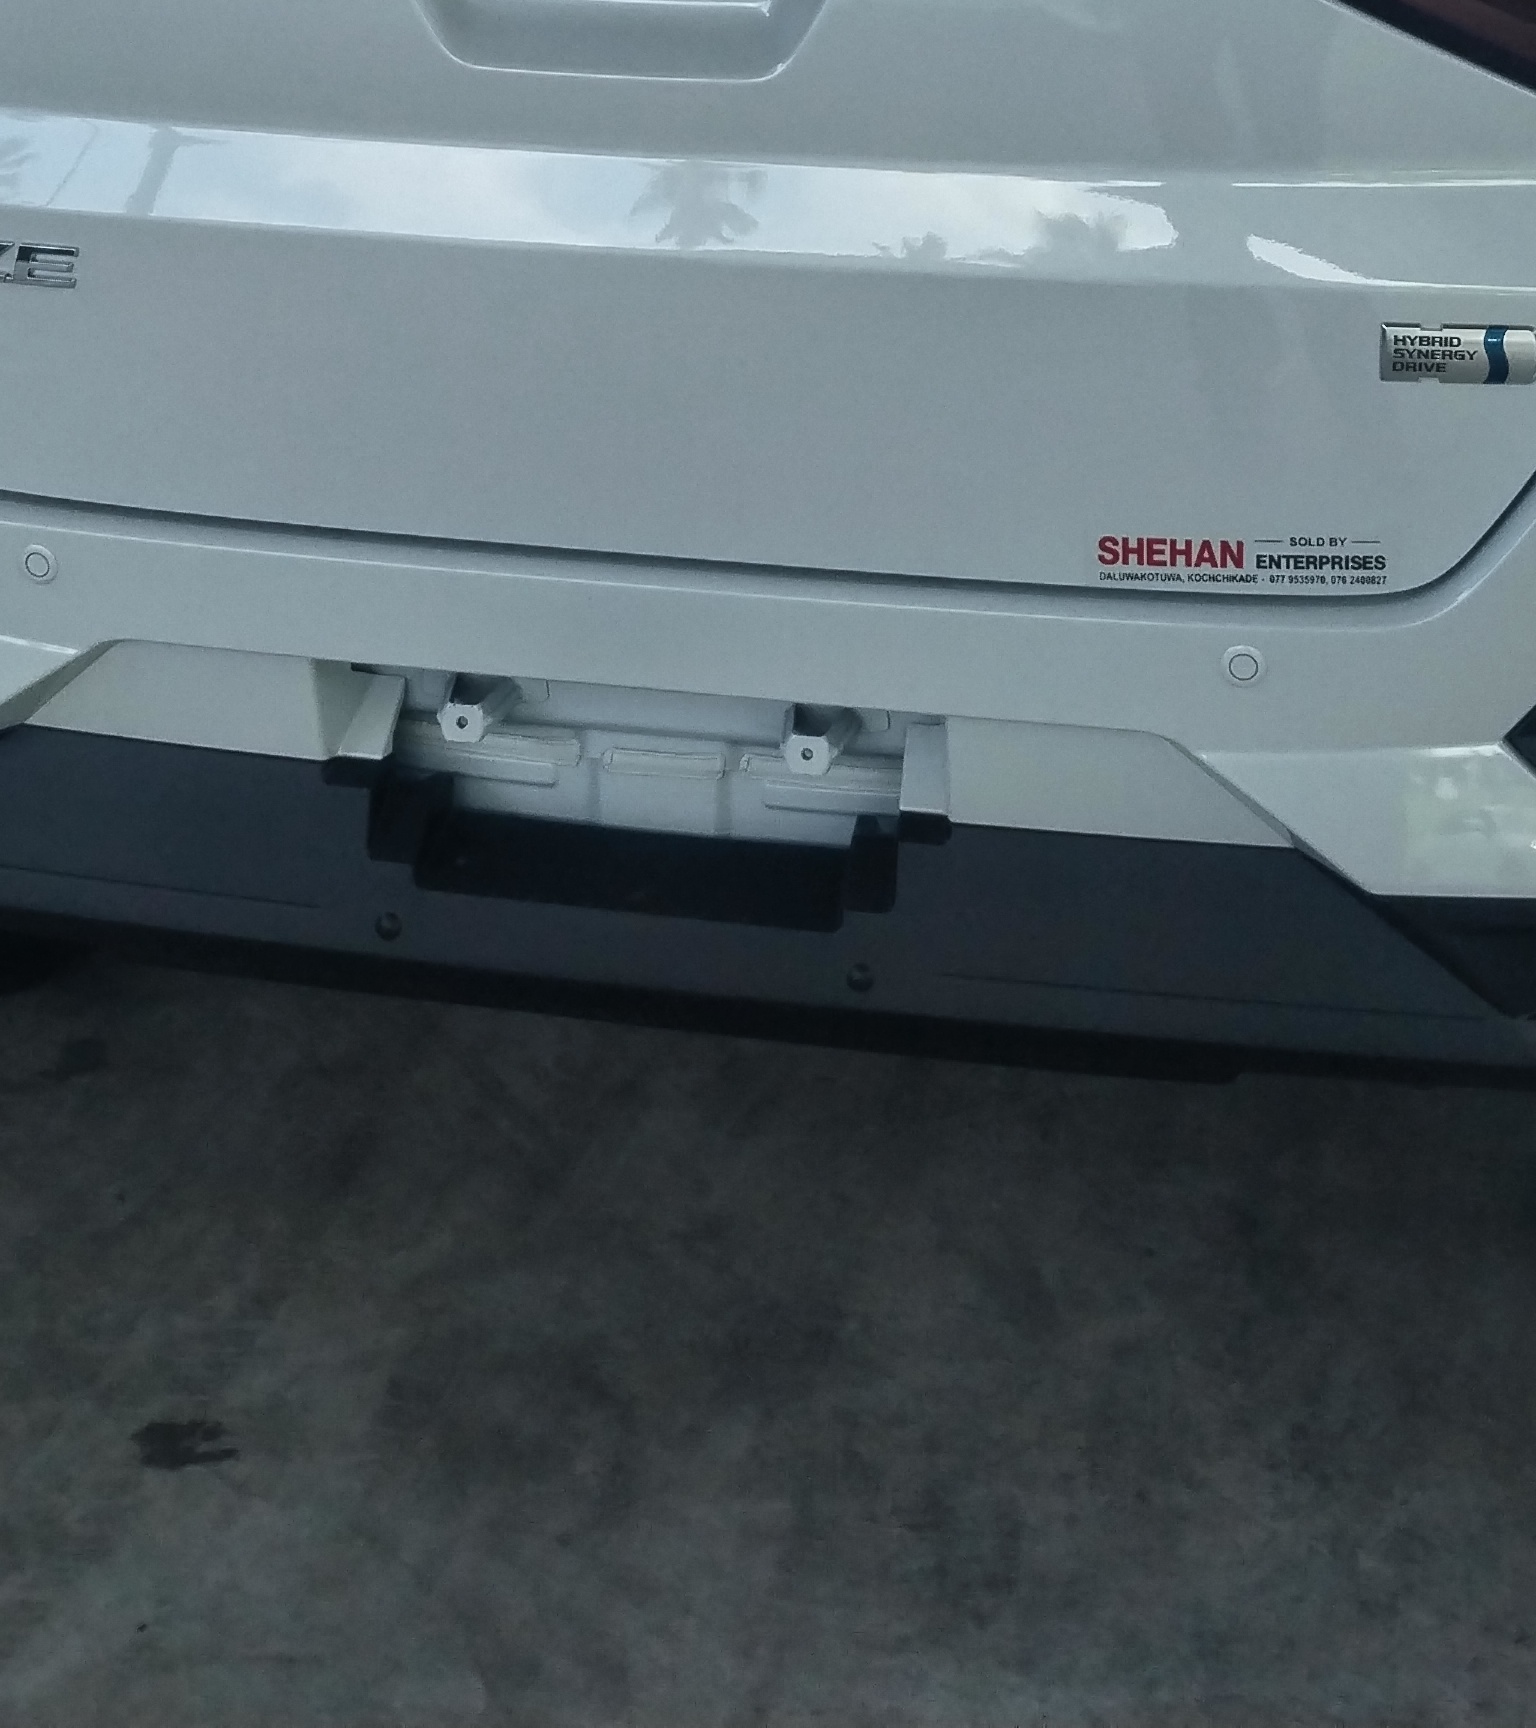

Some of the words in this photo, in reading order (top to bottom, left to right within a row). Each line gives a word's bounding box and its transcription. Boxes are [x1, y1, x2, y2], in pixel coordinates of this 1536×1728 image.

[1393, 335, 1462, 348] HYBRID
[1392, 348, 1478, 361] SYNERGY
[1392, 361, 1447, 373] DRIVE
[1289, 537, 1326, 548] SOLD
[1329, 537, 1347, 547] BY
[1097, 536, 1244, 569] SHEHAN
[1255, 554, 1387, 571] ENTERPRISES
[1187, 573, 1259, 584] KOCHCHIKADE
[1269, 574, 1285, 584] 077
